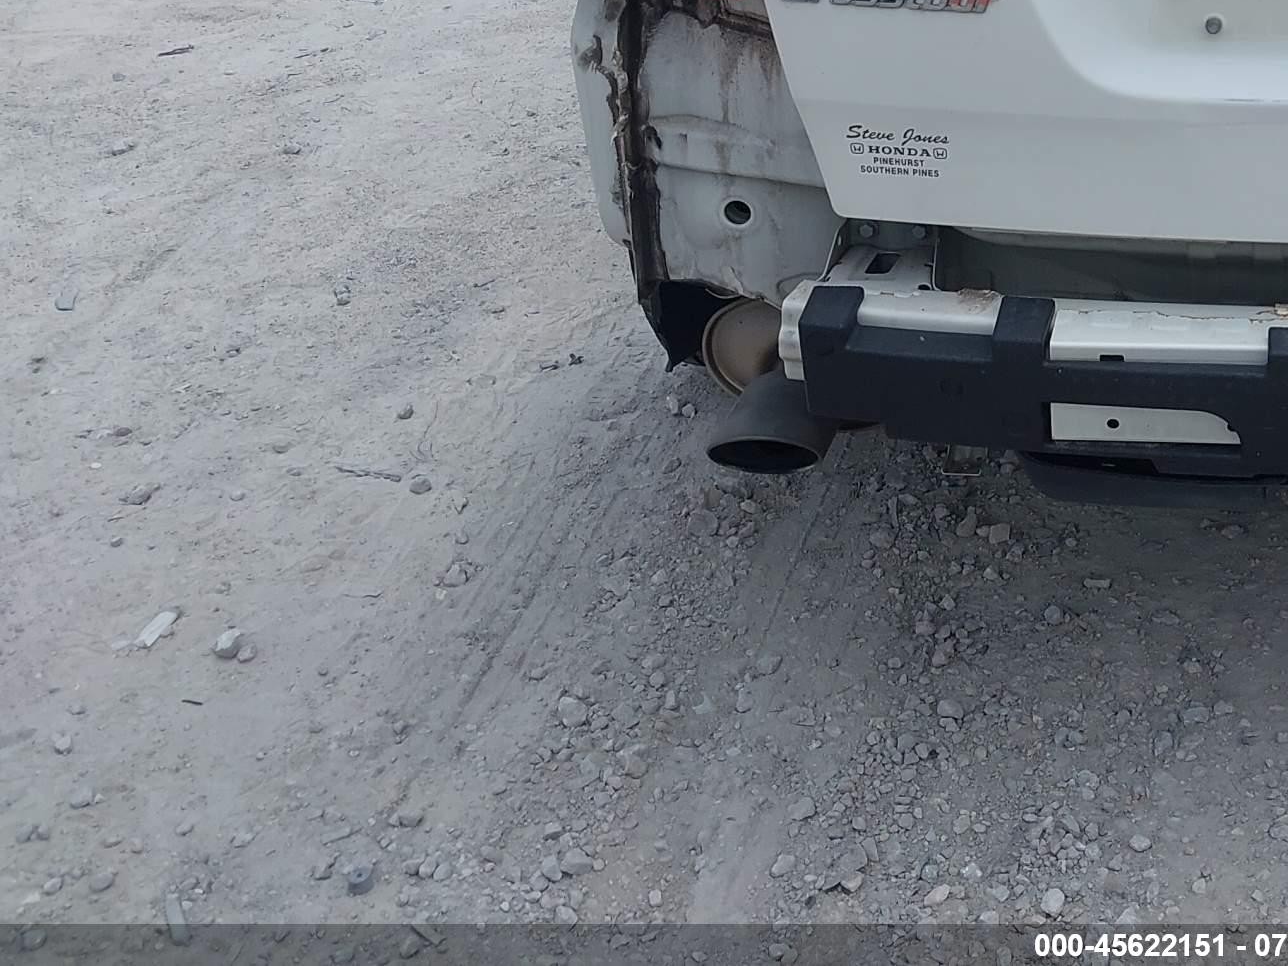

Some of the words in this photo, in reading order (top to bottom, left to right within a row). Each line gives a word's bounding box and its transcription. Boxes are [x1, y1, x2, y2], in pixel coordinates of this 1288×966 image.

[846, 125, 895, 141] Steve
[901, 128, 949, 146] Jones
[868, 146, 931, 157] HONDA
[873, 156, 925, 167] PINEHURST
[860, 165, 909, 175] SOUTHERN
[912, 168, 940, 178] PINES
